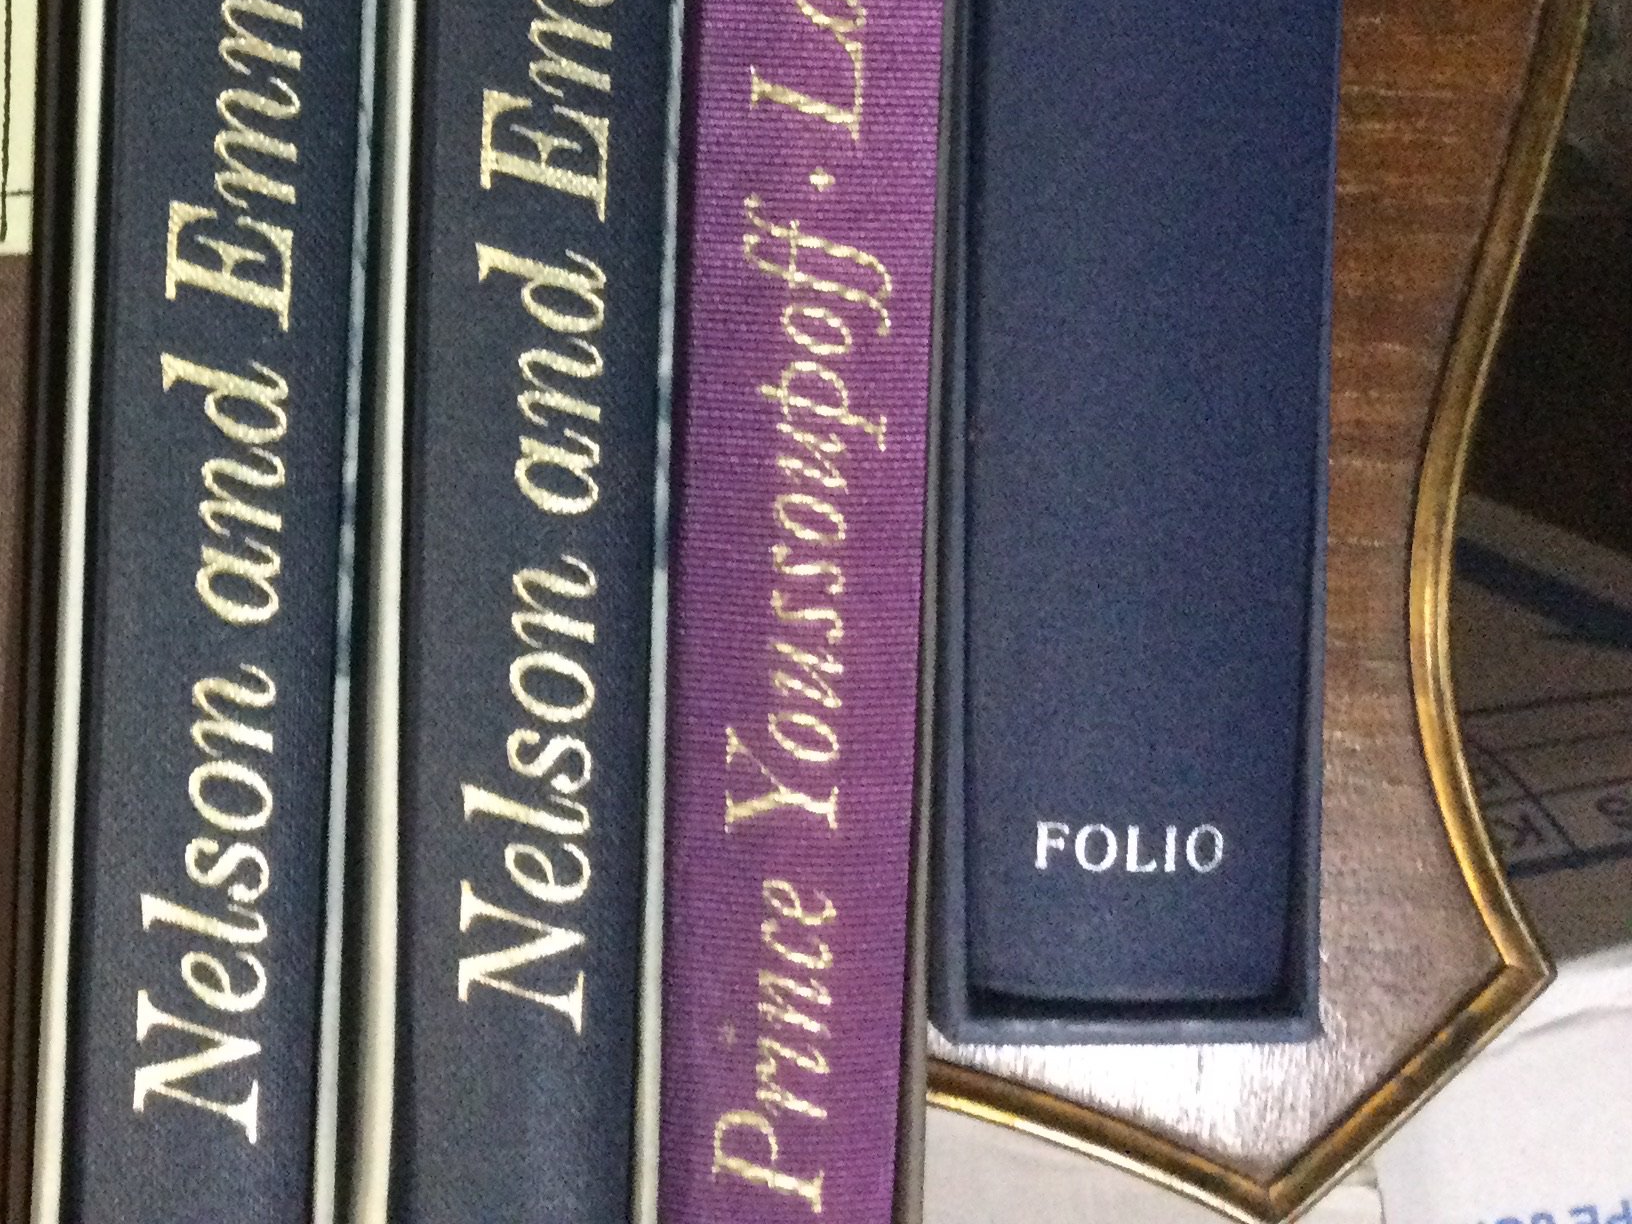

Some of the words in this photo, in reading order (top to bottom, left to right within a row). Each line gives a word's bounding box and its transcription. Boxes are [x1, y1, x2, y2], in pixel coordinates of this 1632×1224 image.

[162, 353, 290, 626] and
[475, 242, 608, 515] and
[724, 194, 892, 833] Youssoupoff
[133, 664, 278, 1145] Nelson
[458, 553, 598, 1035] Nelson
[1034, 821, 1225, 874] FOLIO
[712, 879, 837, 1214] Prince
